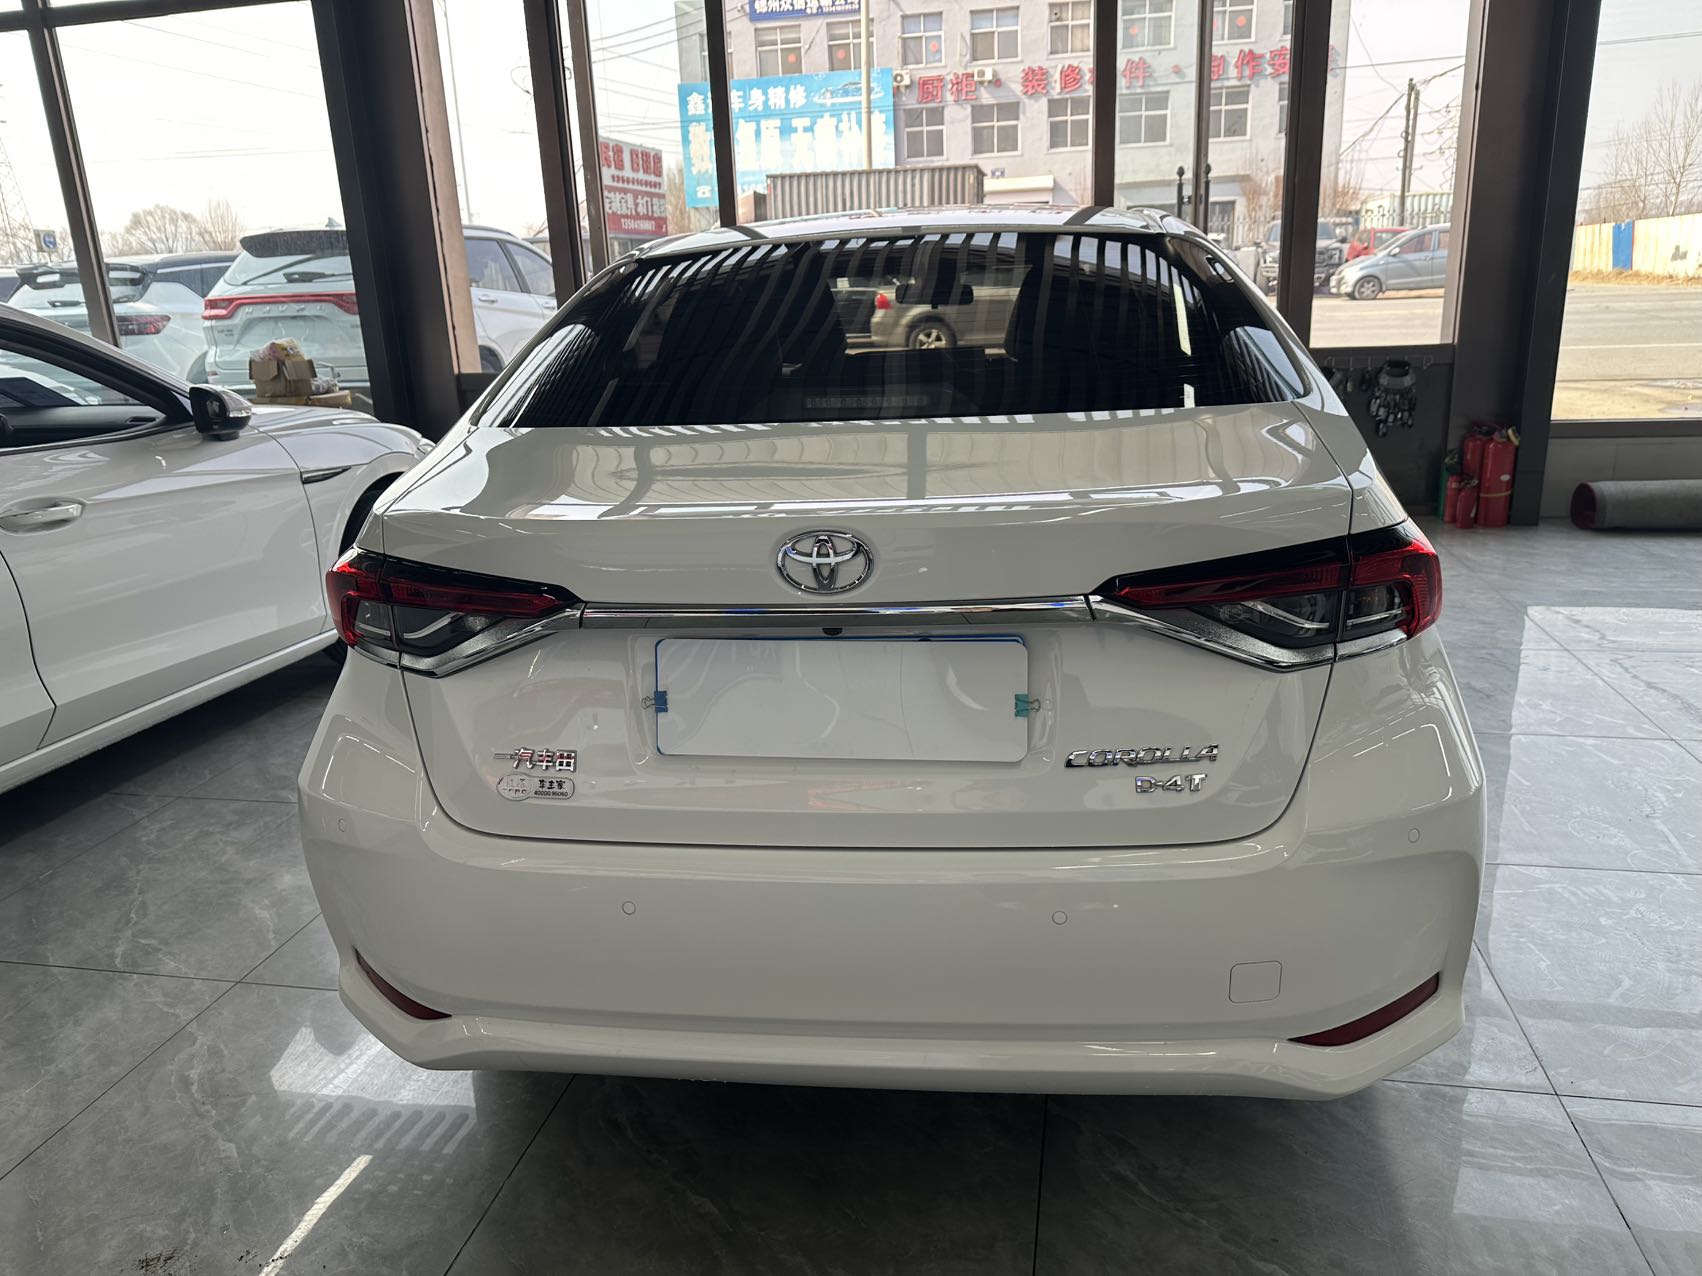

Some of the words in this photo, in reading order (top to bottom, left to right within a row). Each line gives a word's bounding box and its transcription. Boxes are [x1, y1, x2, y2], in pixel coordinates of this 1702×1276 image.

[686, 83, 807, 116] 鑫车身精修
[494, 747, 577, 772] 一汽丰田
[1065, 744, 1219, 767] COROLLA
[1135, 773, 1207, 793] D-4T
